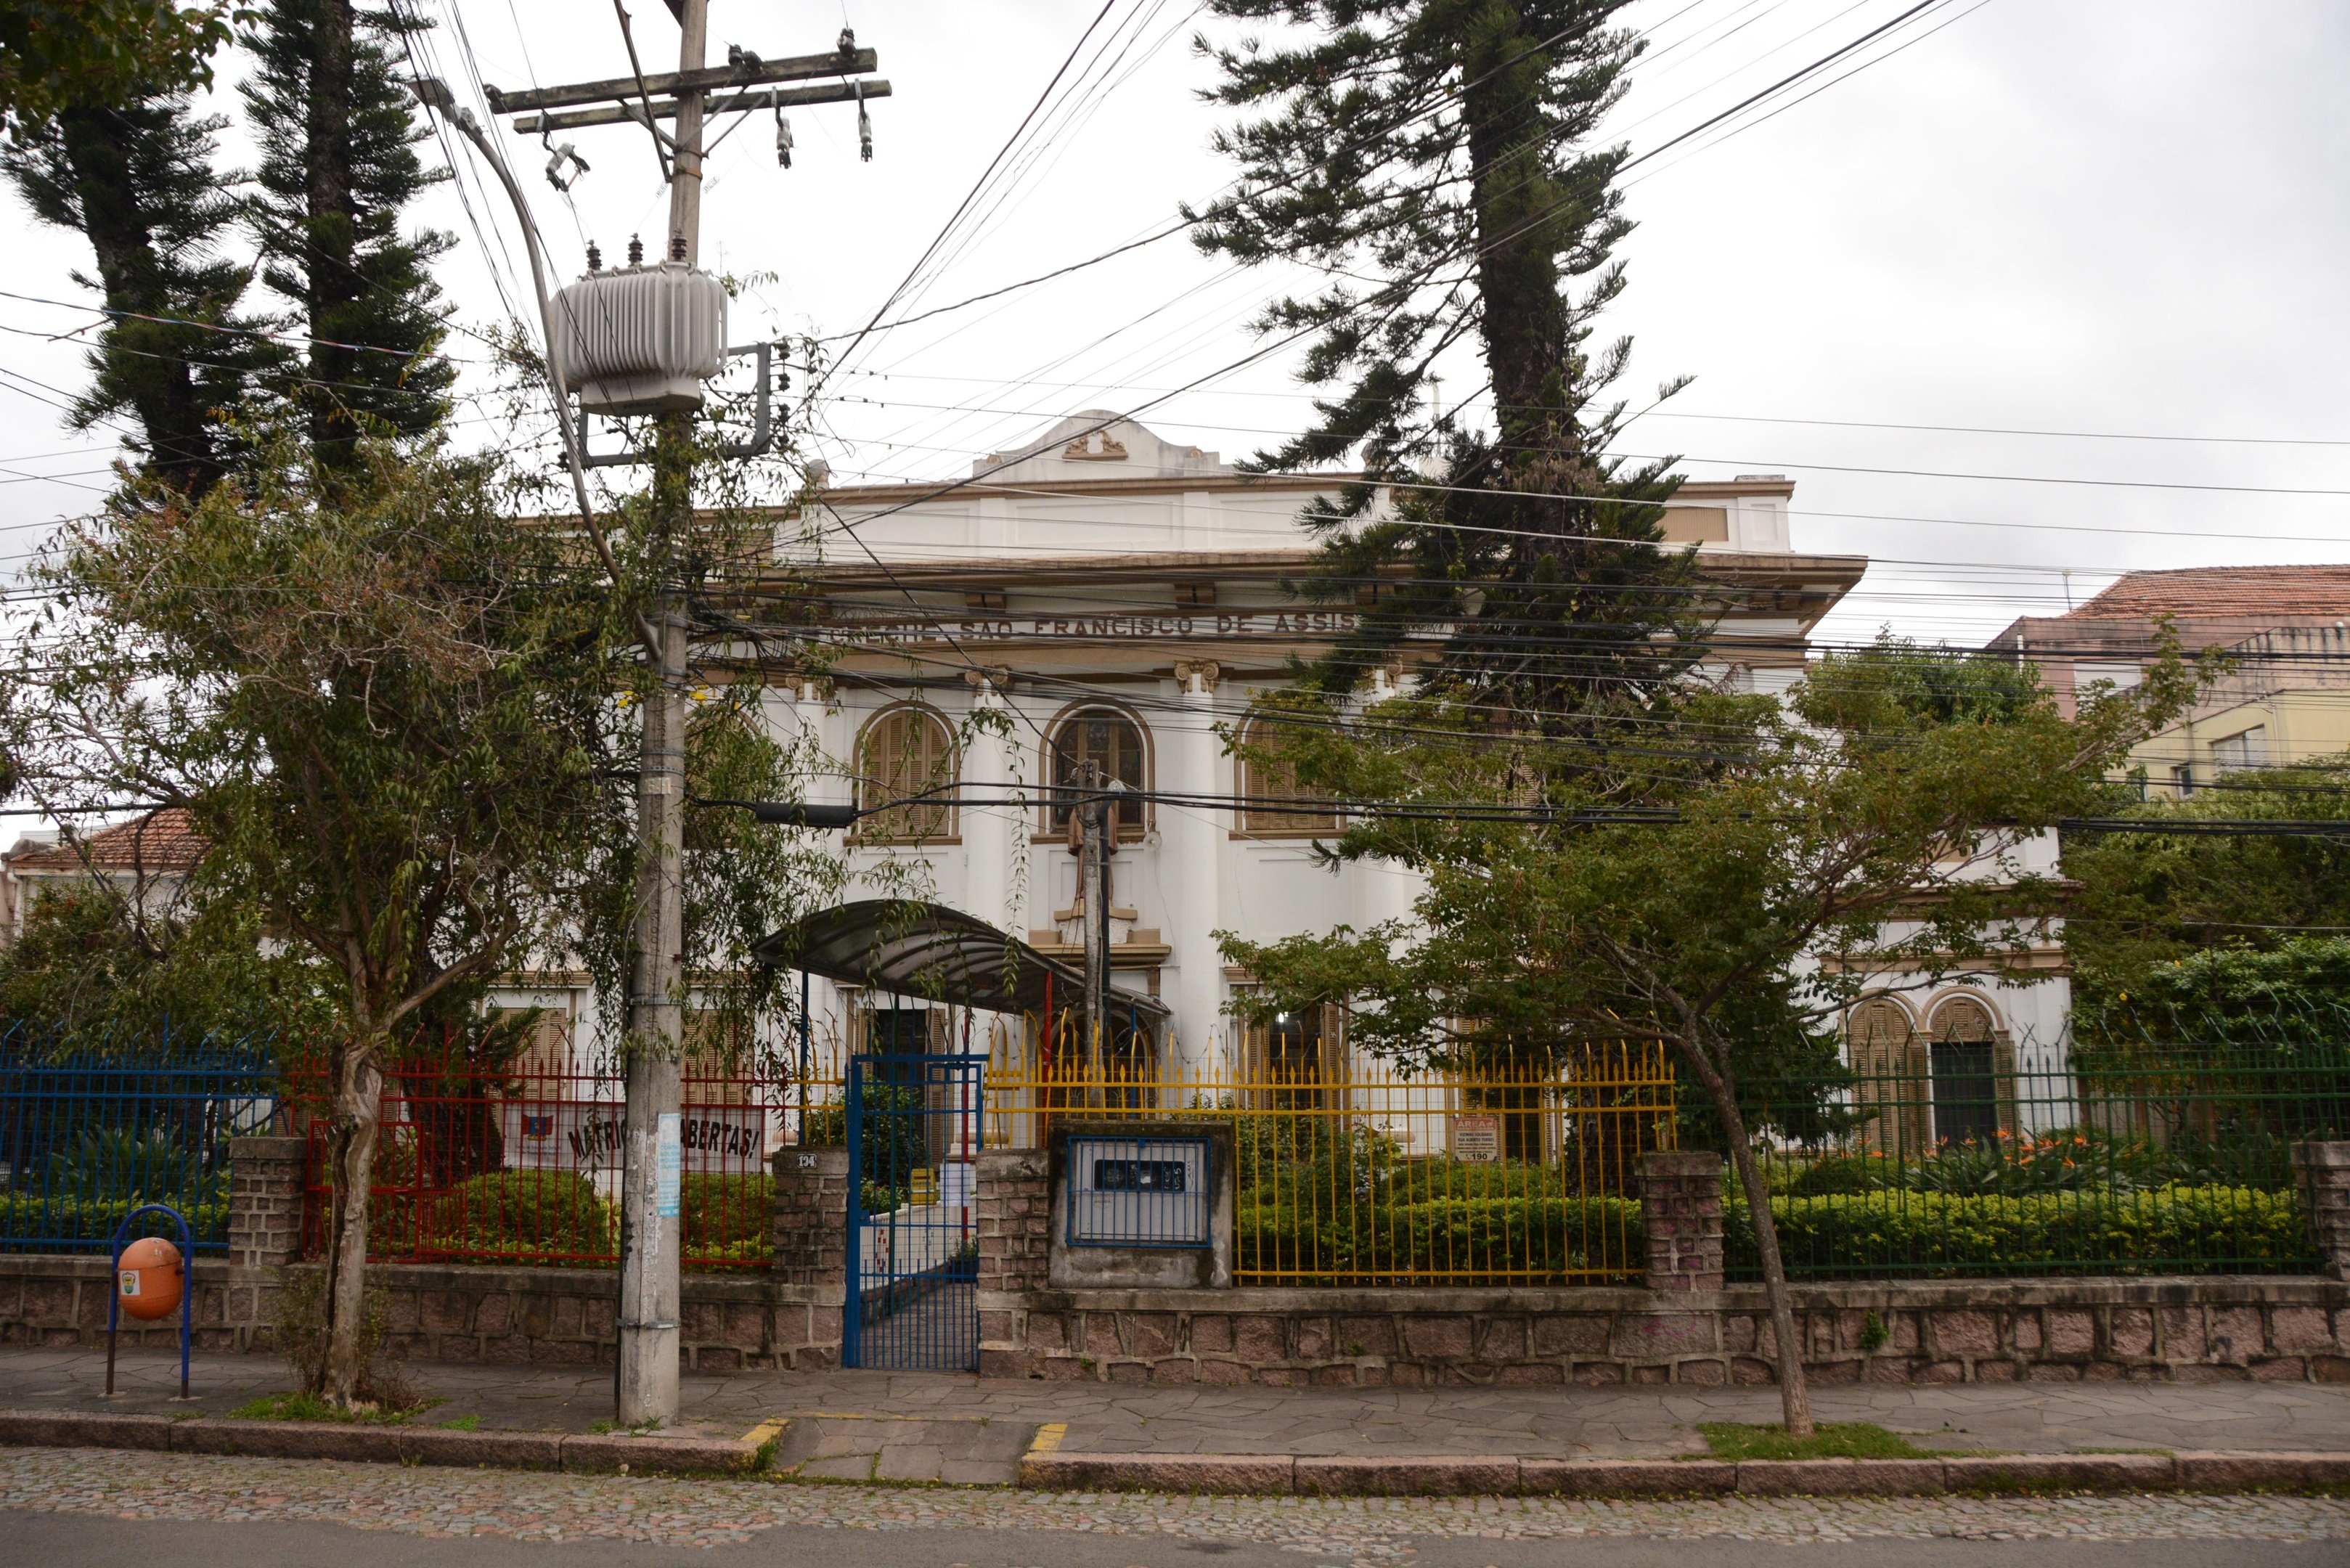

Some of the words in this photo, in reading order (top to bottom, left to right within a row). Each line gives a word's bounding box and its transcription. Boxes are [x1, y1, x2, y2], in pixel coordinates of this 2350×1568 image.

[1035, 617, 1193, 636] FRANCISCO
[1217, 615, 1253, 633] DE
[1273, 613, 1355, 632] ASSIS
[680, 1119, 760, 1159] ABERTAS!
